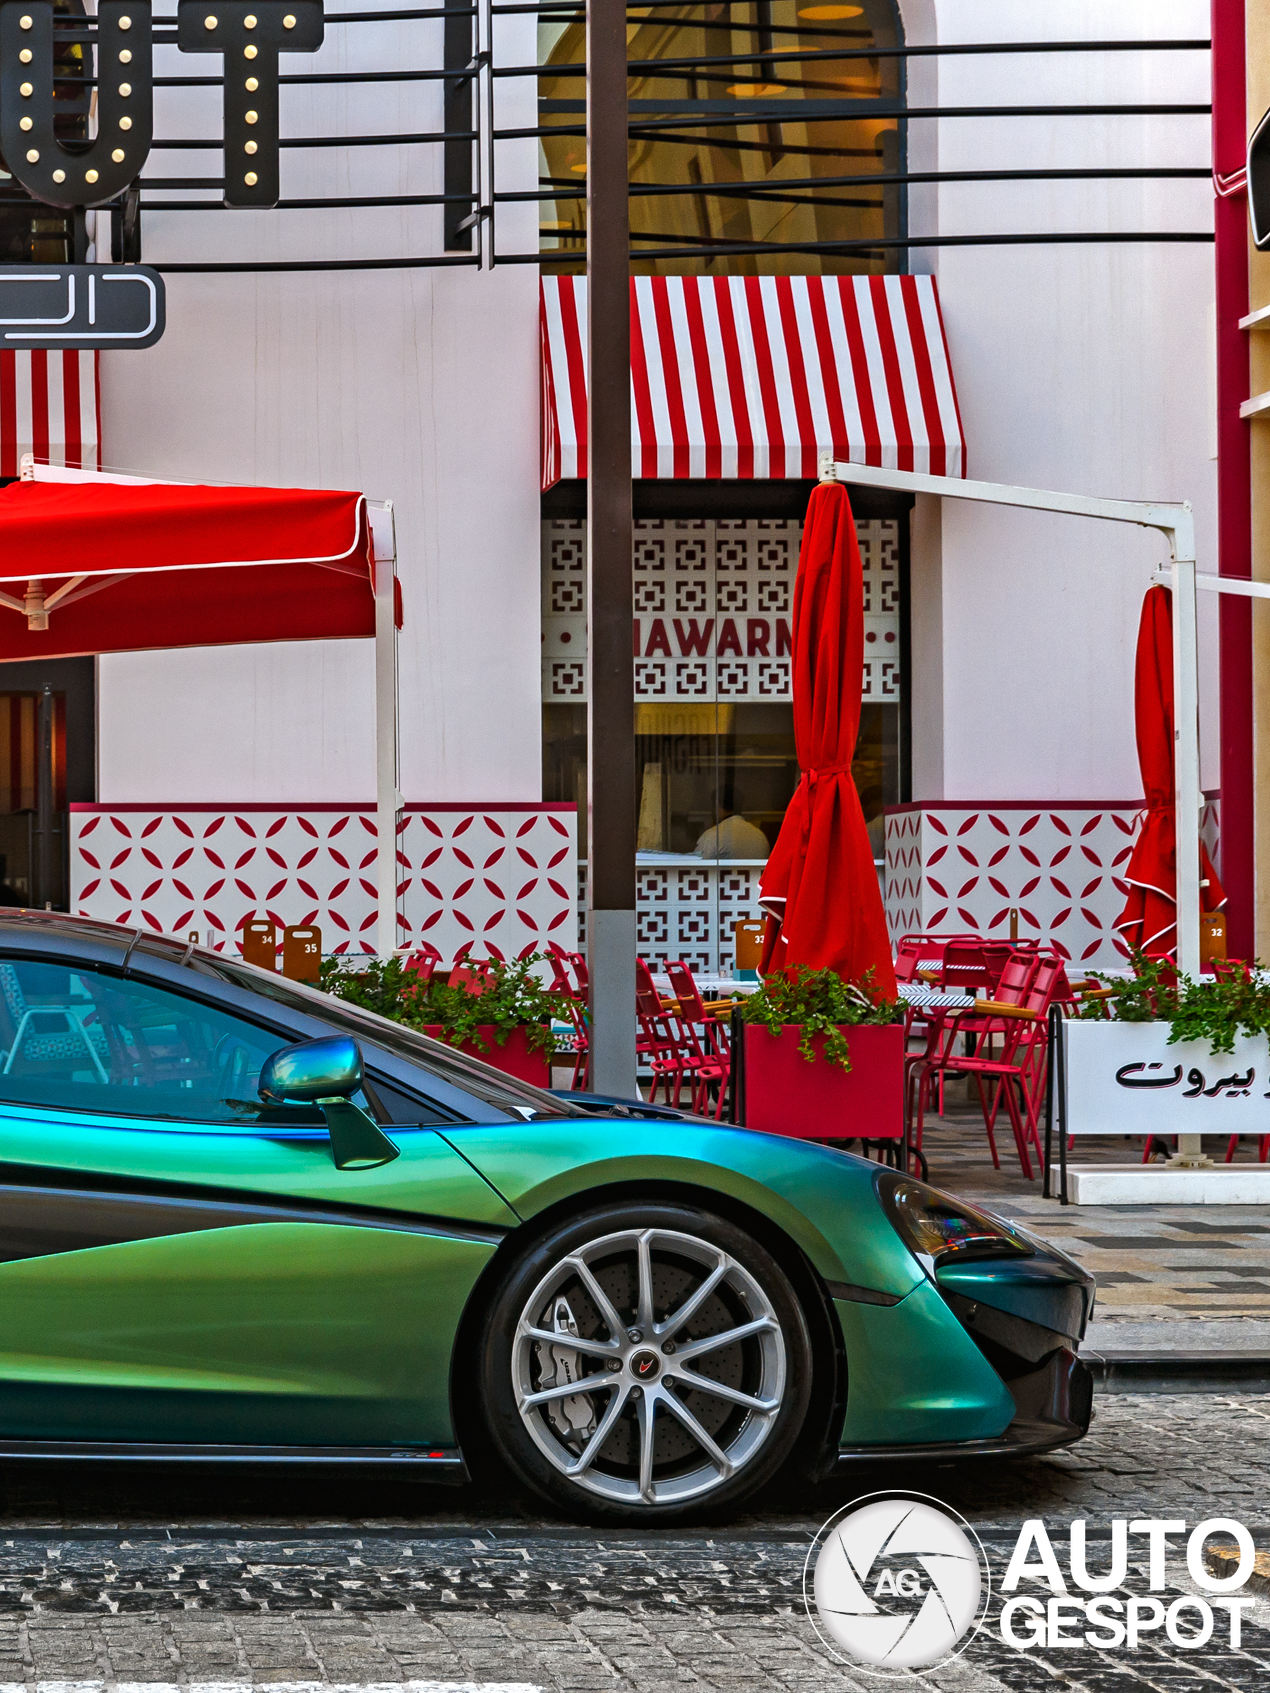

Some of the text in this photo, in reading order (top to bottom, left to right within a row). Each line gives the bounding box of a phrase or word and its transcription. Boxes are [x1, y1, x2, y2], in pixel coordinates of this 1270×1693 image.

[1210, 927, 1223, 937] 32
[261, 935, 273, 945] 34
[304, 943, 318, 953] 35
[1115, 1062, 1255, 1098] بيروت
